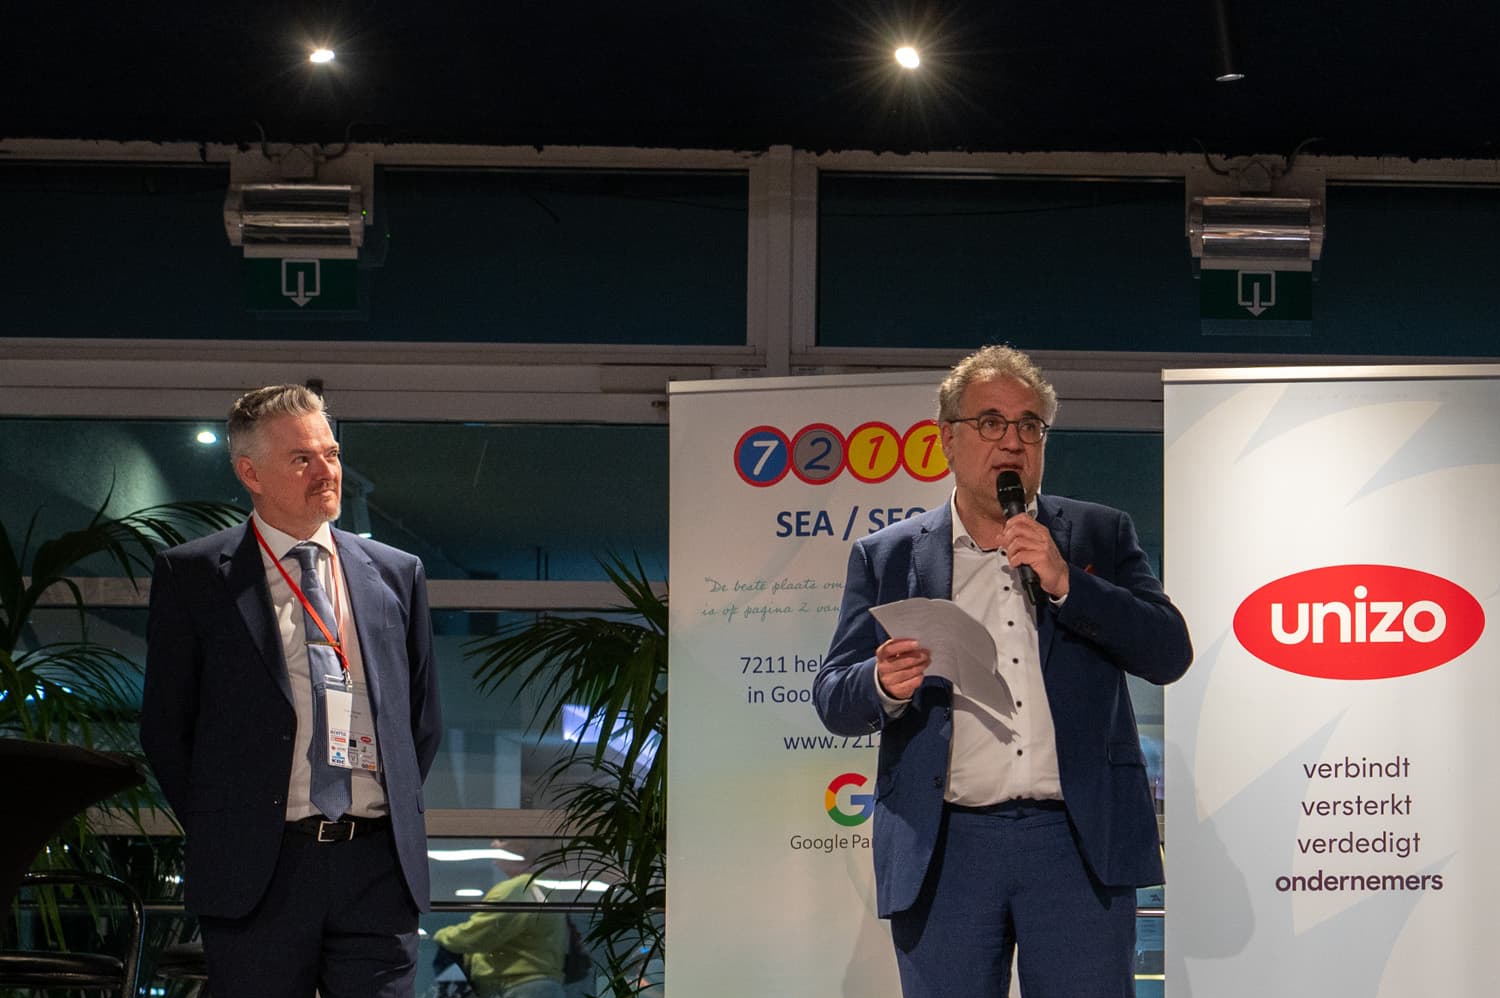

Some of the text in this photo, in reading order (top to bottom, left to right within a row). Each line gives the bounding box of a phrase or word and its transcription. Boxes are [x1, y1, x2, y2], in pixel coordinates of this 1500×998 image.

[776, 511, 834, 537] SEA
[843, 506, 859, 541] /
[734, 579, 768, 592] beste
[771, 577, 817, 595] plaats
[743, 601, 793, 623] pagina
[798, 602, 808, 613] 2
[1271, 585, 1447, 644] unizo
[740, 656, 787, 674] 7211
[748, 686, 813, 704] in Goo
[784, 735, 881, 750] www.721
[1303, 756, 1411, 778] verbindt
[1301, 793, 1413, 816] versterkt
[790, 834, 872, 854] Google Pa
[1298, 831, 1421, 858] verdedigt
[1275, 870, 1443, 892] ondernemers
